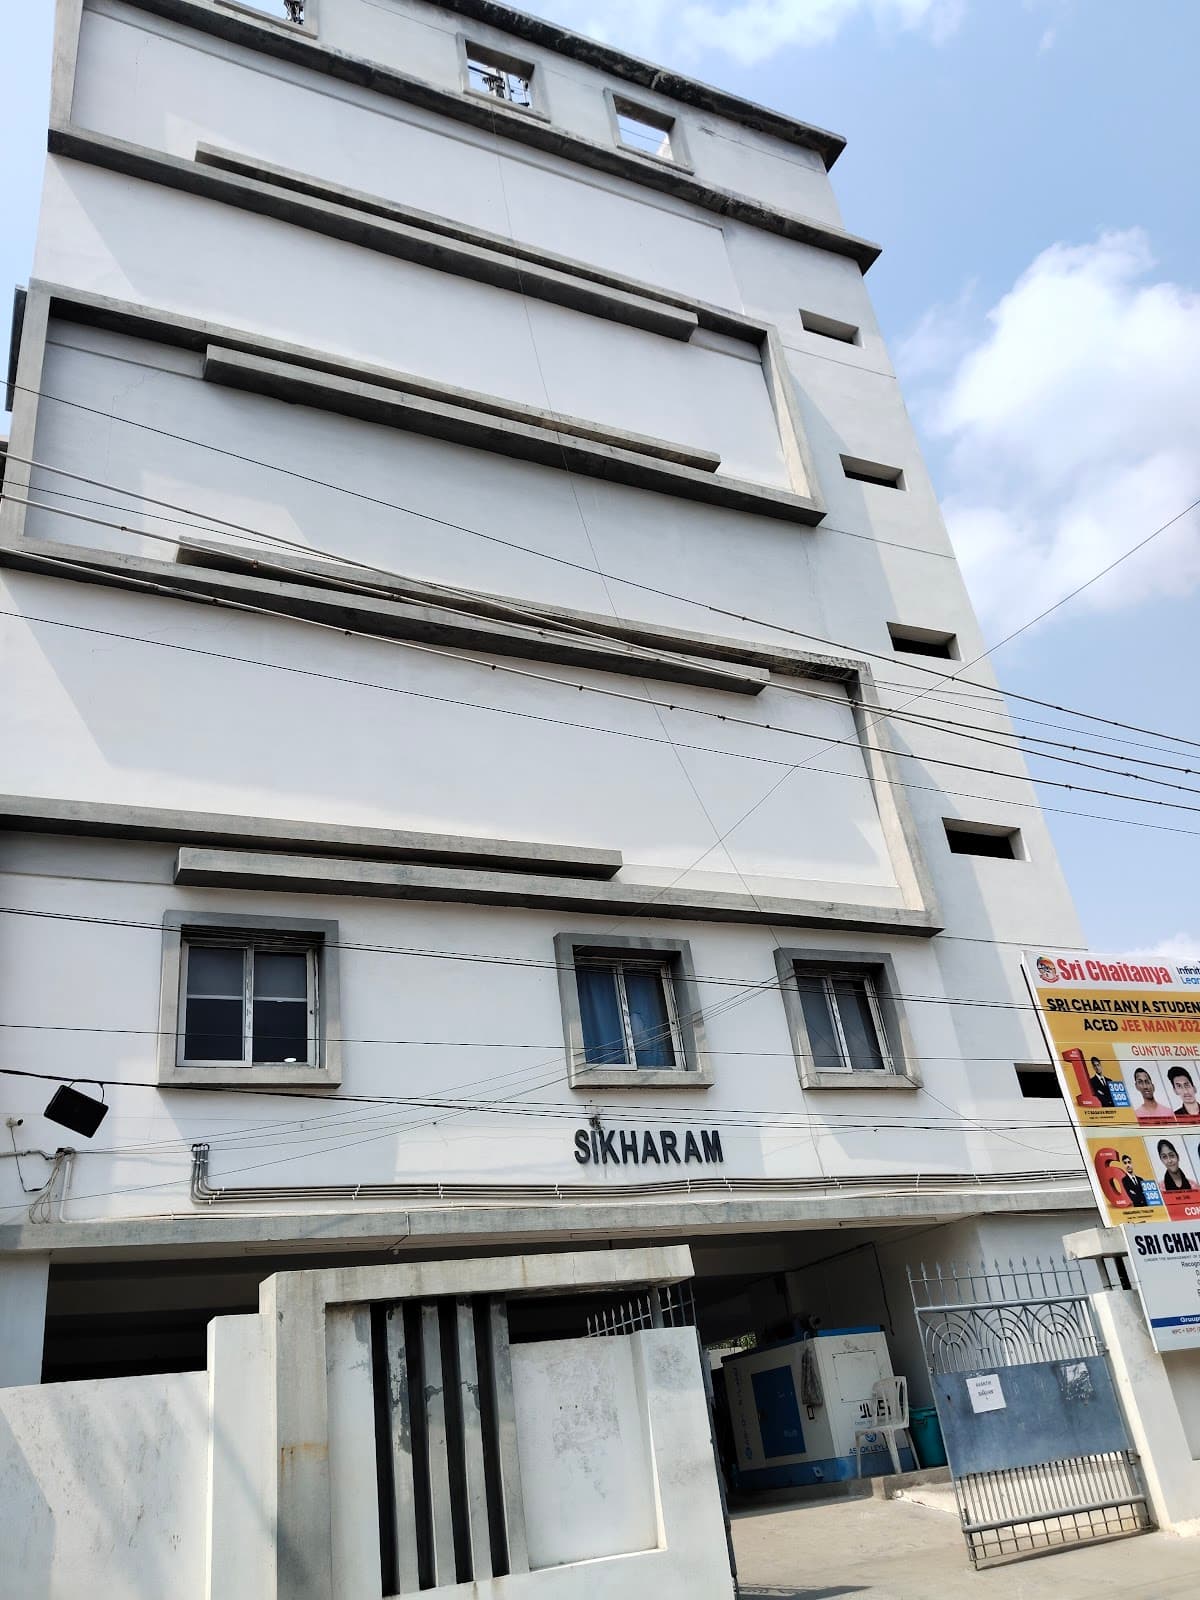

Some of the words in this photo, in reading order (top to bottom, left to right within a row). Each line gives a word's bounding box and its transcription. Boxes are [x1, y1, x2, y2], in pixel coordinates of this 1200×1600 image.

[1057, 958, 1086, 980] Sri
[1086, 960, 1173, 985] Chaitanya
[1046, 998, 1070, 1012] SRI
[1071, 999, 1151, 1013] CHAITANYA
[1151, 1001, 1200, 1013] STUDEN
[1084, 1018, 1118, 1032] ACED
[1121, 1019, 1142, 1032] JEE
[1143, 1020, 1177, 1033] MAIN
[1131, 1045, 1172, 1057] GUNTUR
[1174, 1046, 1199, 1057] ZONE
[1108, 1083, 1124, 1091] 300
[574, 1129, 724, 1165] SIKHARAM
[1134, 1234, 1163, 1256] SRI
